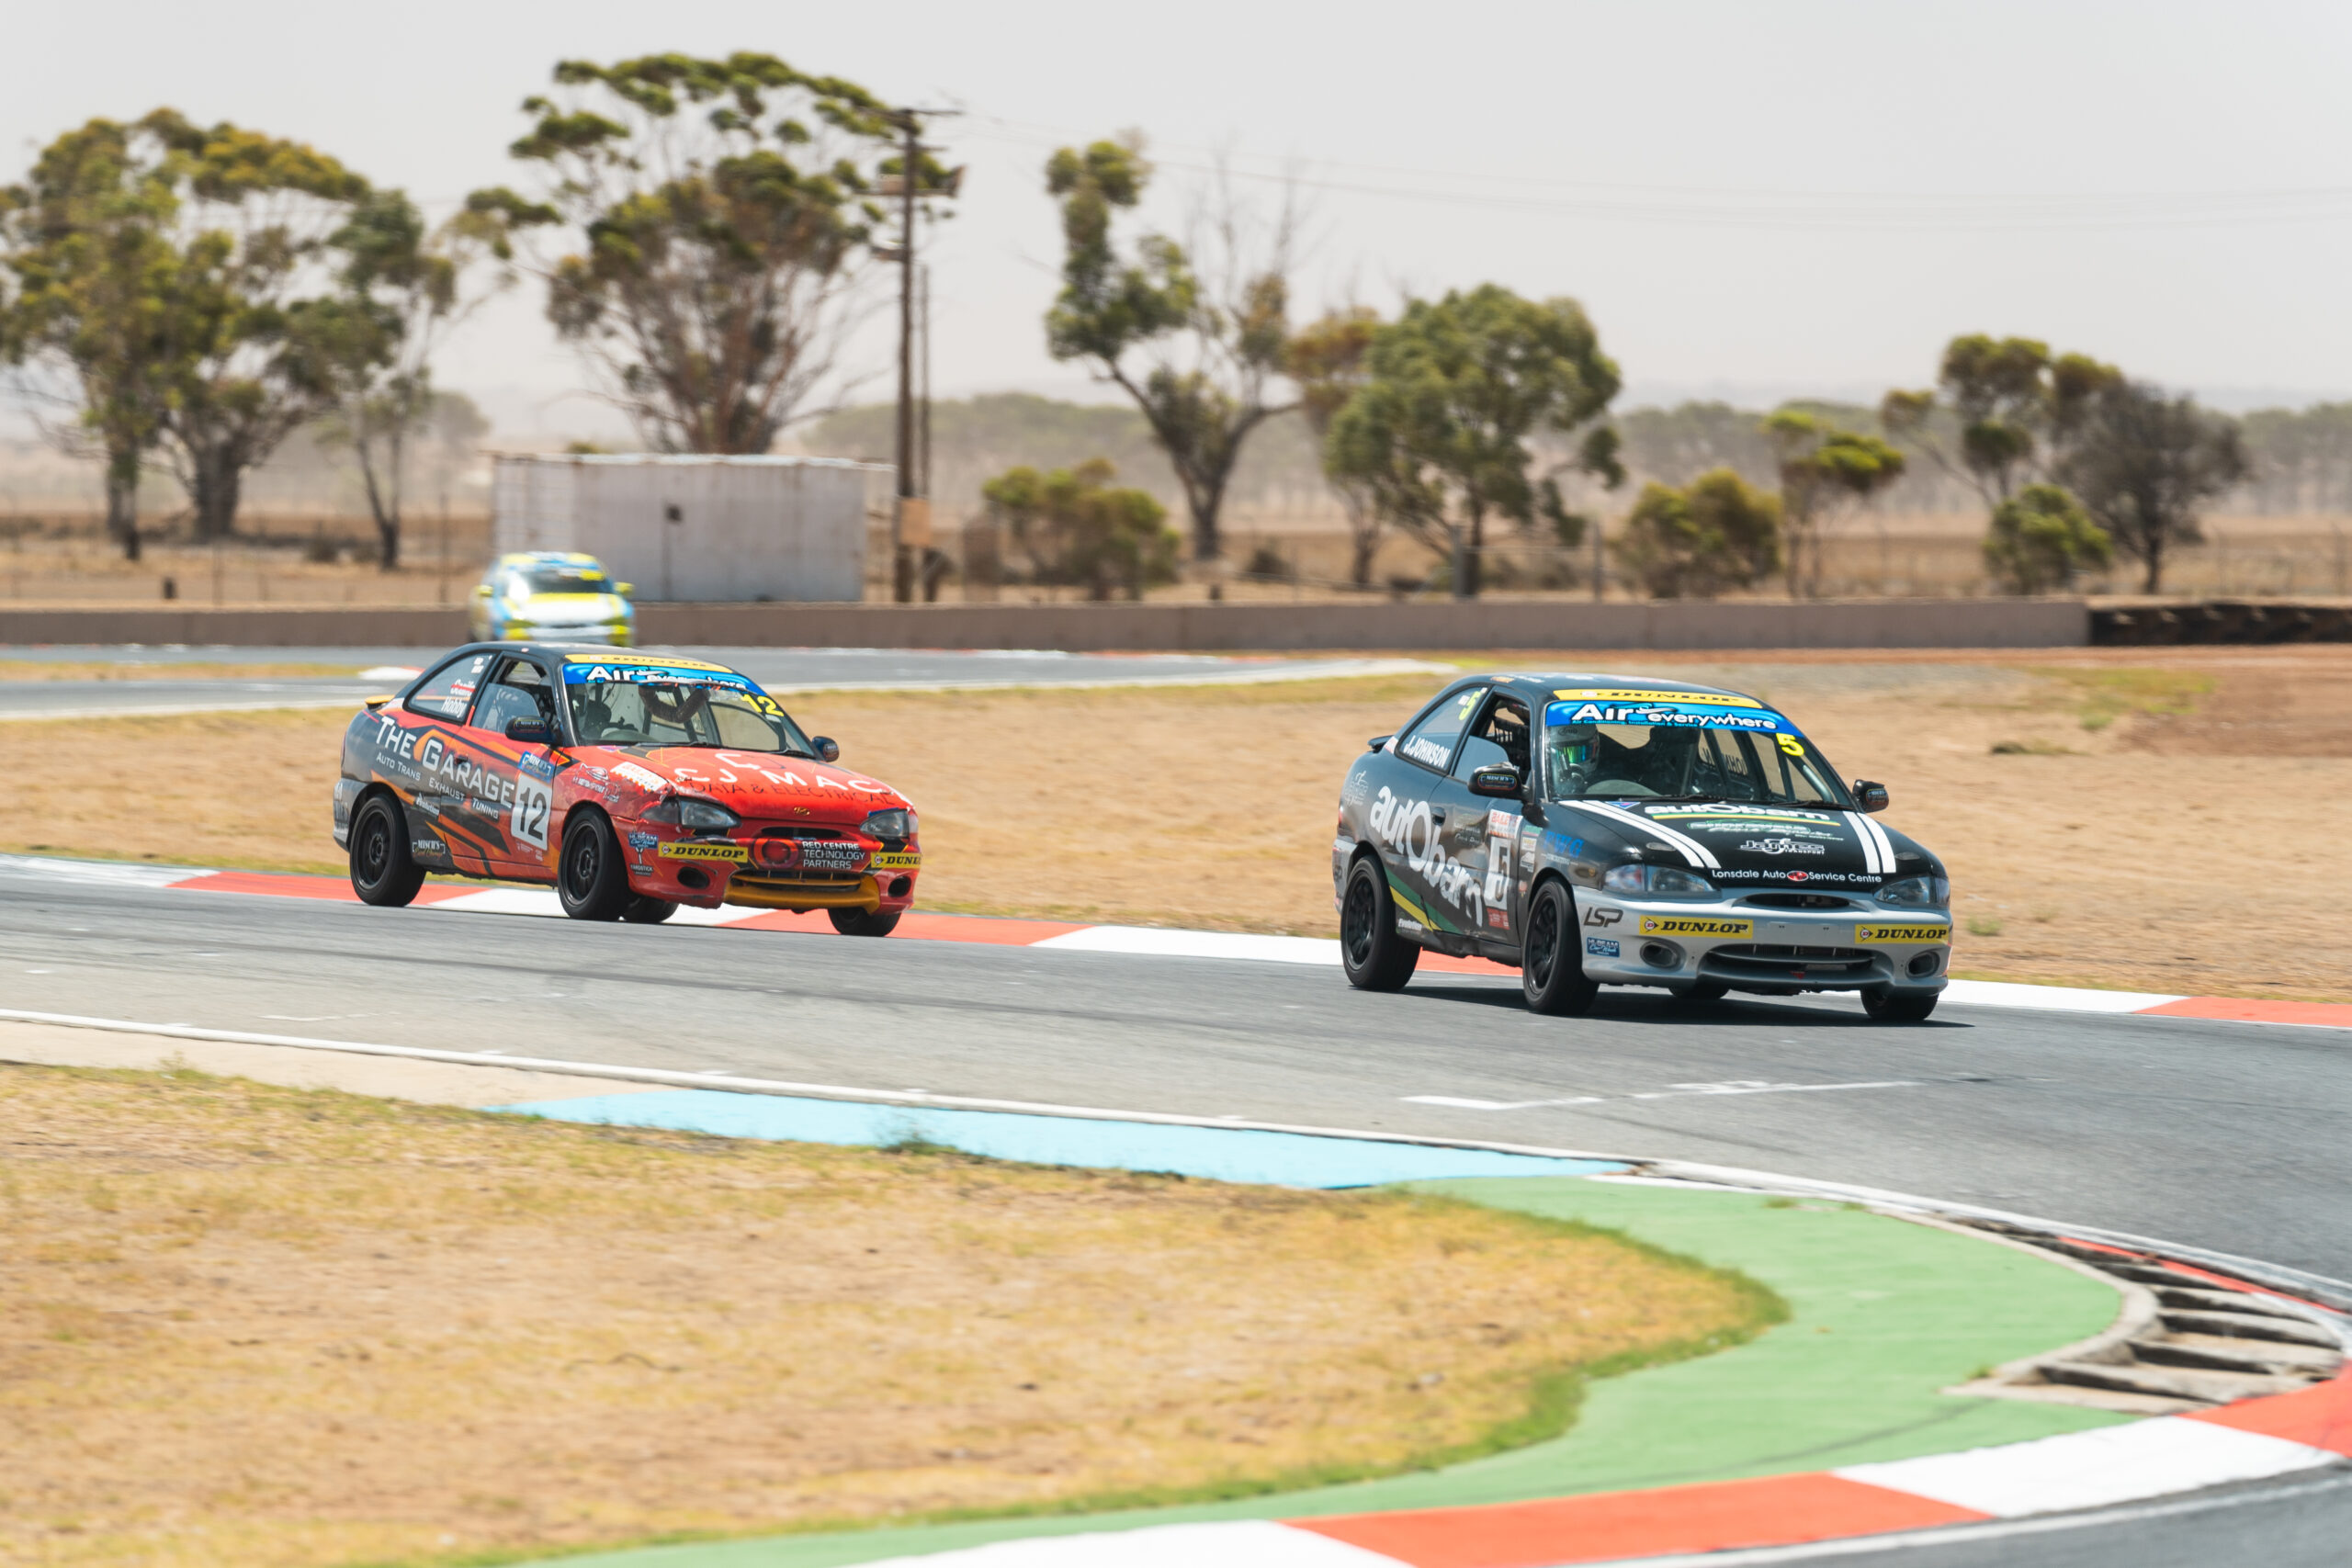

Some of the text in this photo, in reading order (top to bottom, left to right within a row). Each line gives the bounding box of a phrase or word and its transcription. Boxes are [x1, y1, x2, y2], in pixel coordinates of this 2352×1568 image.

[586, 666, 635, 681] Air
[741, 694, 784, 716] 12
[1459, 691, 1481, 721] 5
[1571, 704, 1778, 730] Air everywhere
[1776, 733, 1804, 757] 5
[376, 716, 515, 808] THE GARAGE
[376, 752, 421, 781] AUTO TRANS
[428, 777, 465, 801] EXHAUST
[472, 798, 499, 819] TUNING
[519, 786, 548, 840] 12
[673, 846, 745, 858] DUNLOP
[802, 841, 860, 851] RED CENTRE
[804, 850, 865, 860] TECHNOLOGY
[803, 860, 852, 869] PARTNERS
[887, 856, 920, 865] DUNL
[1712, 869, 1882, 883] Lonsdale Auto Service Centre
[1584, 907, 1623, 928] LSP
[1661, 921, 1748, 933] DUNLOP
[1875, 929, 1947, 939] DUNLOP
